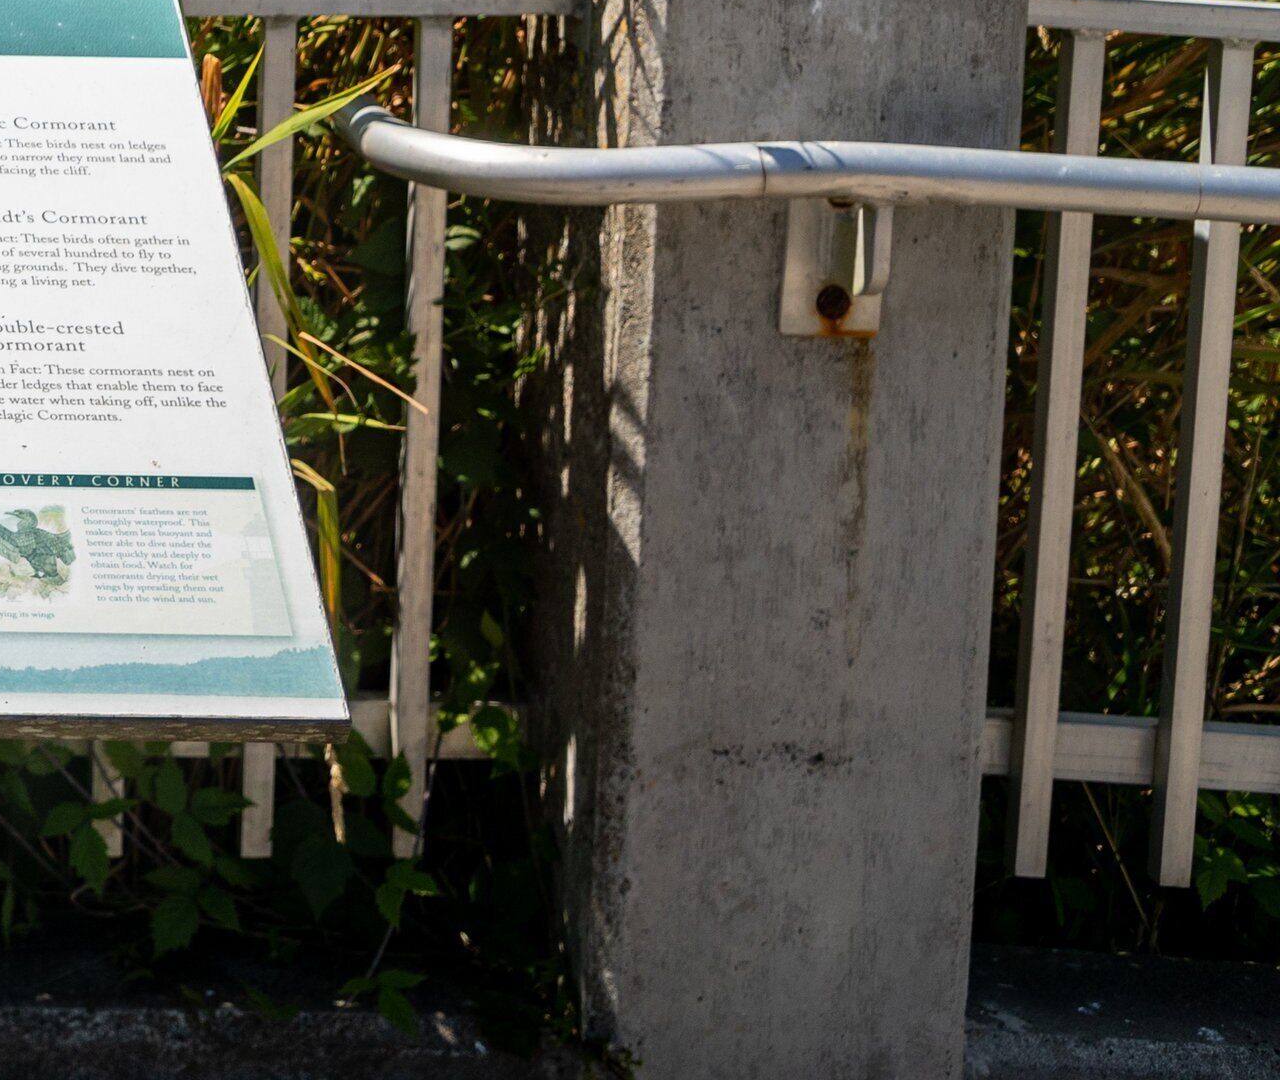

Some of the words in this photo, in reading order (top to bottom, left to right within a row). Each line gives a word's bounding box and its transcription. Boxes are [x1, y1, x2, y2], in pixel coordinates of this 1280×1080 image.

[13, 117, 117, 130] Cormorant
[5, 139, 43, 148] These
[46, 139, 76, 149] birds
[128, 140, 166, 153] ledges
[57, 153, 82, 164] they
[87, 155, 115, 163] must
[119, 154, 145, 163] land
[149, 155, 171, 164] and
[41, 210, 148, 225] Cormorant
[2, 248, 16, 257] of
[18, 248, 60, 258] several
[64, 249, 117, 259] hundred
[122, 250, 134, 259] to
[139, 249, 154, 261] fly
[159, 251, 171, 260] to
[22, 379, 62, 392] ledges
[66, 380, 92, 390] that
[97, 381, 138, 391] enable
[142, 382, 176, 392] them
[180, 384, 193, 392] to
[198, 382, 223, 393] face
[92, 476, 180, 487] CORNER
